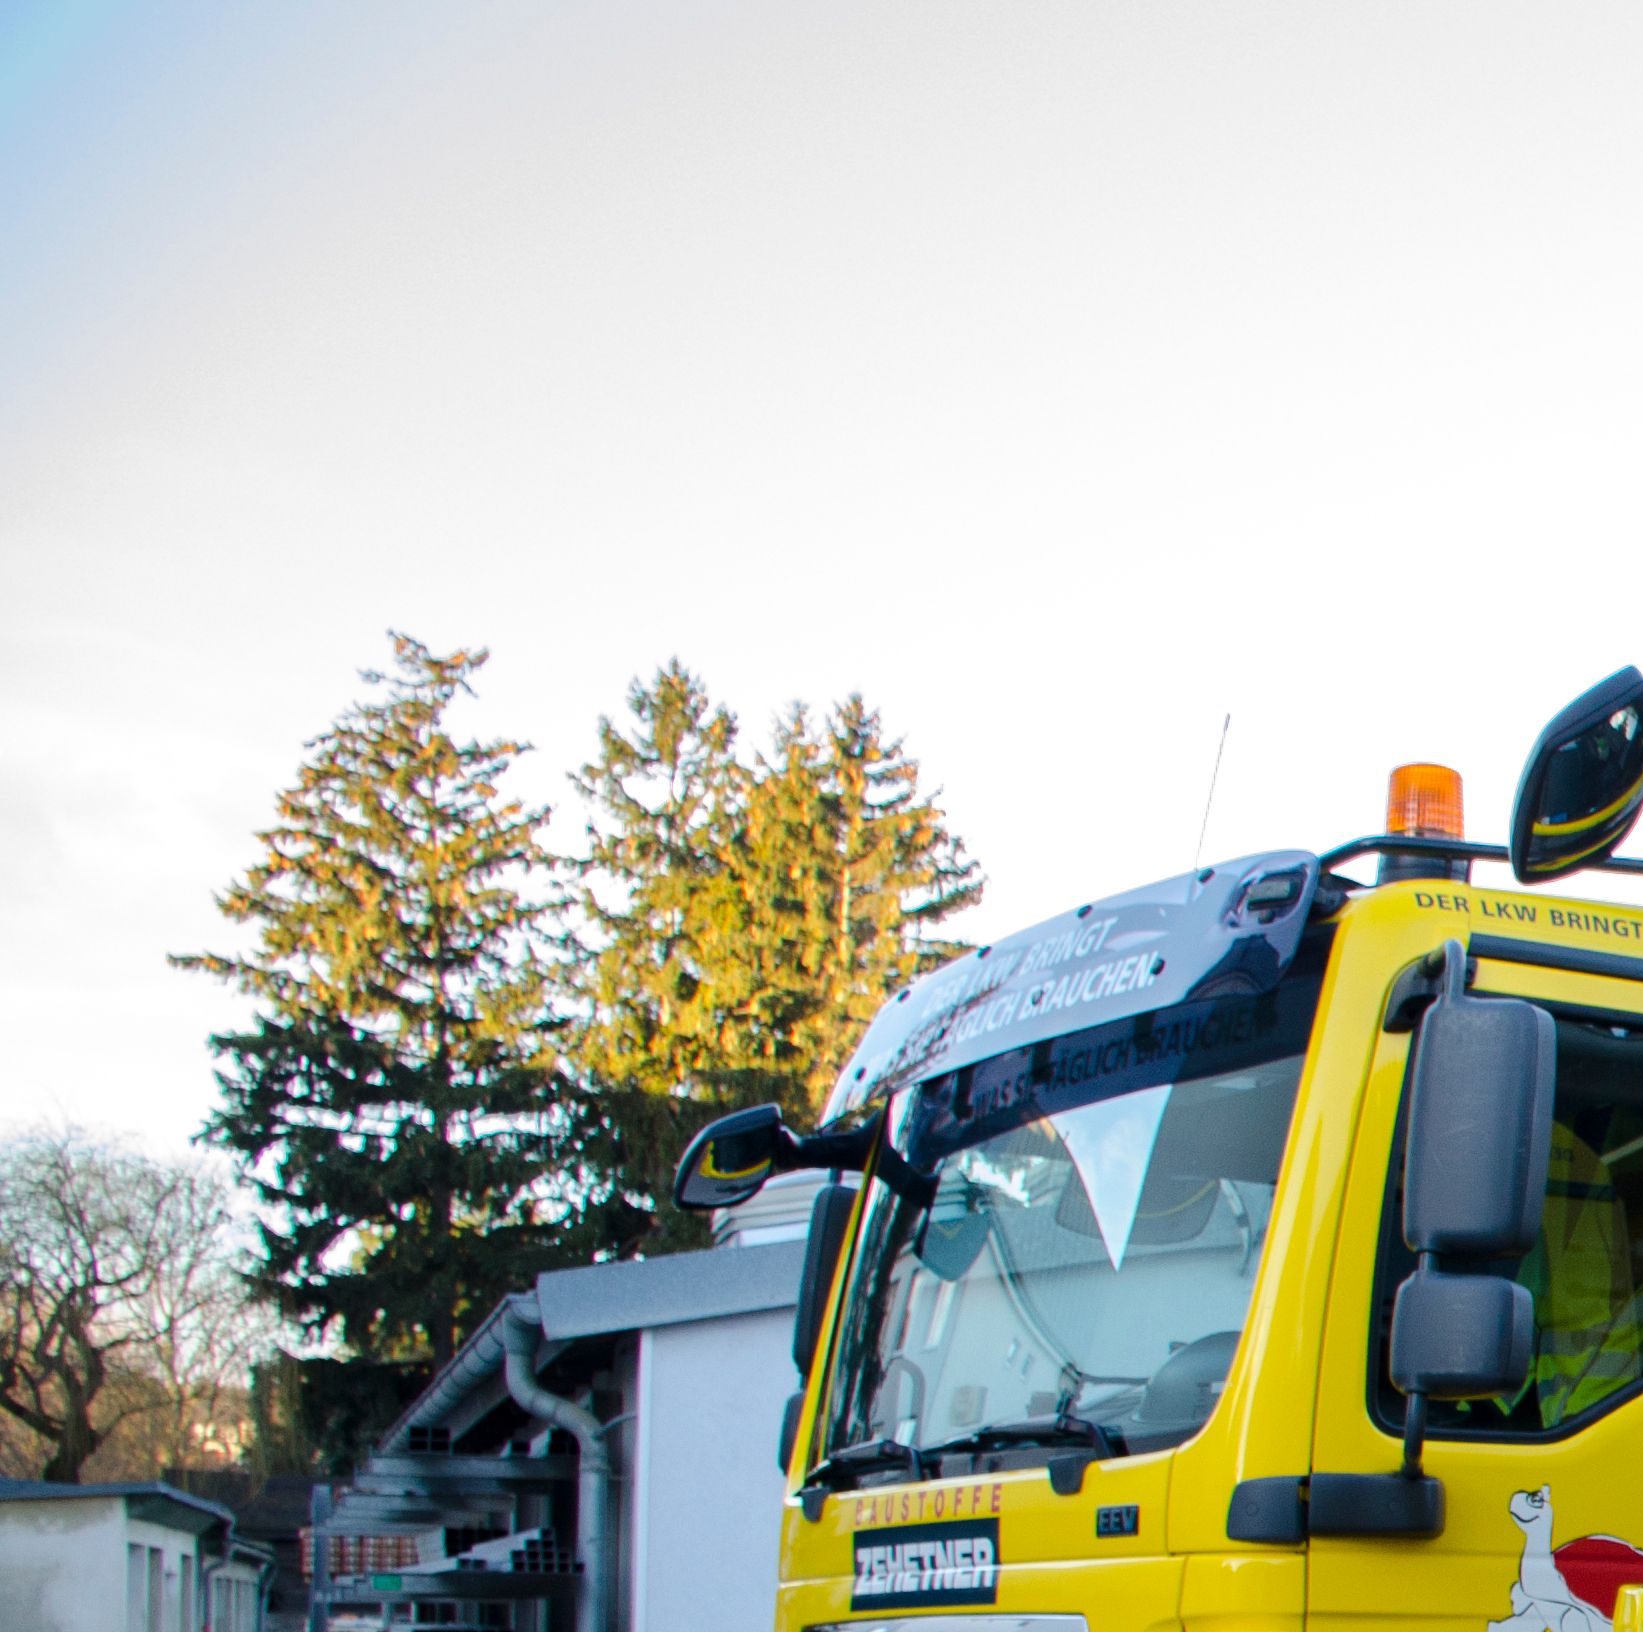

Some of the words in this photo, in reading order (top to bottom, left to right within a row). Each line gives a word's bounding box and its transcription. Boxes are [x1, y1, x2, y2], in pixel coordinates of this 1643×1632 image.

[1414, 892, 1471, 914] DER
[1479, 899, 1537, 923] LKW
[855, 1483, 1003, 1527] BAUSTOFFE
[1100, 1507, 1137, 1533] EEV
[854, 1536, 995, 1596] ZEHETNER
